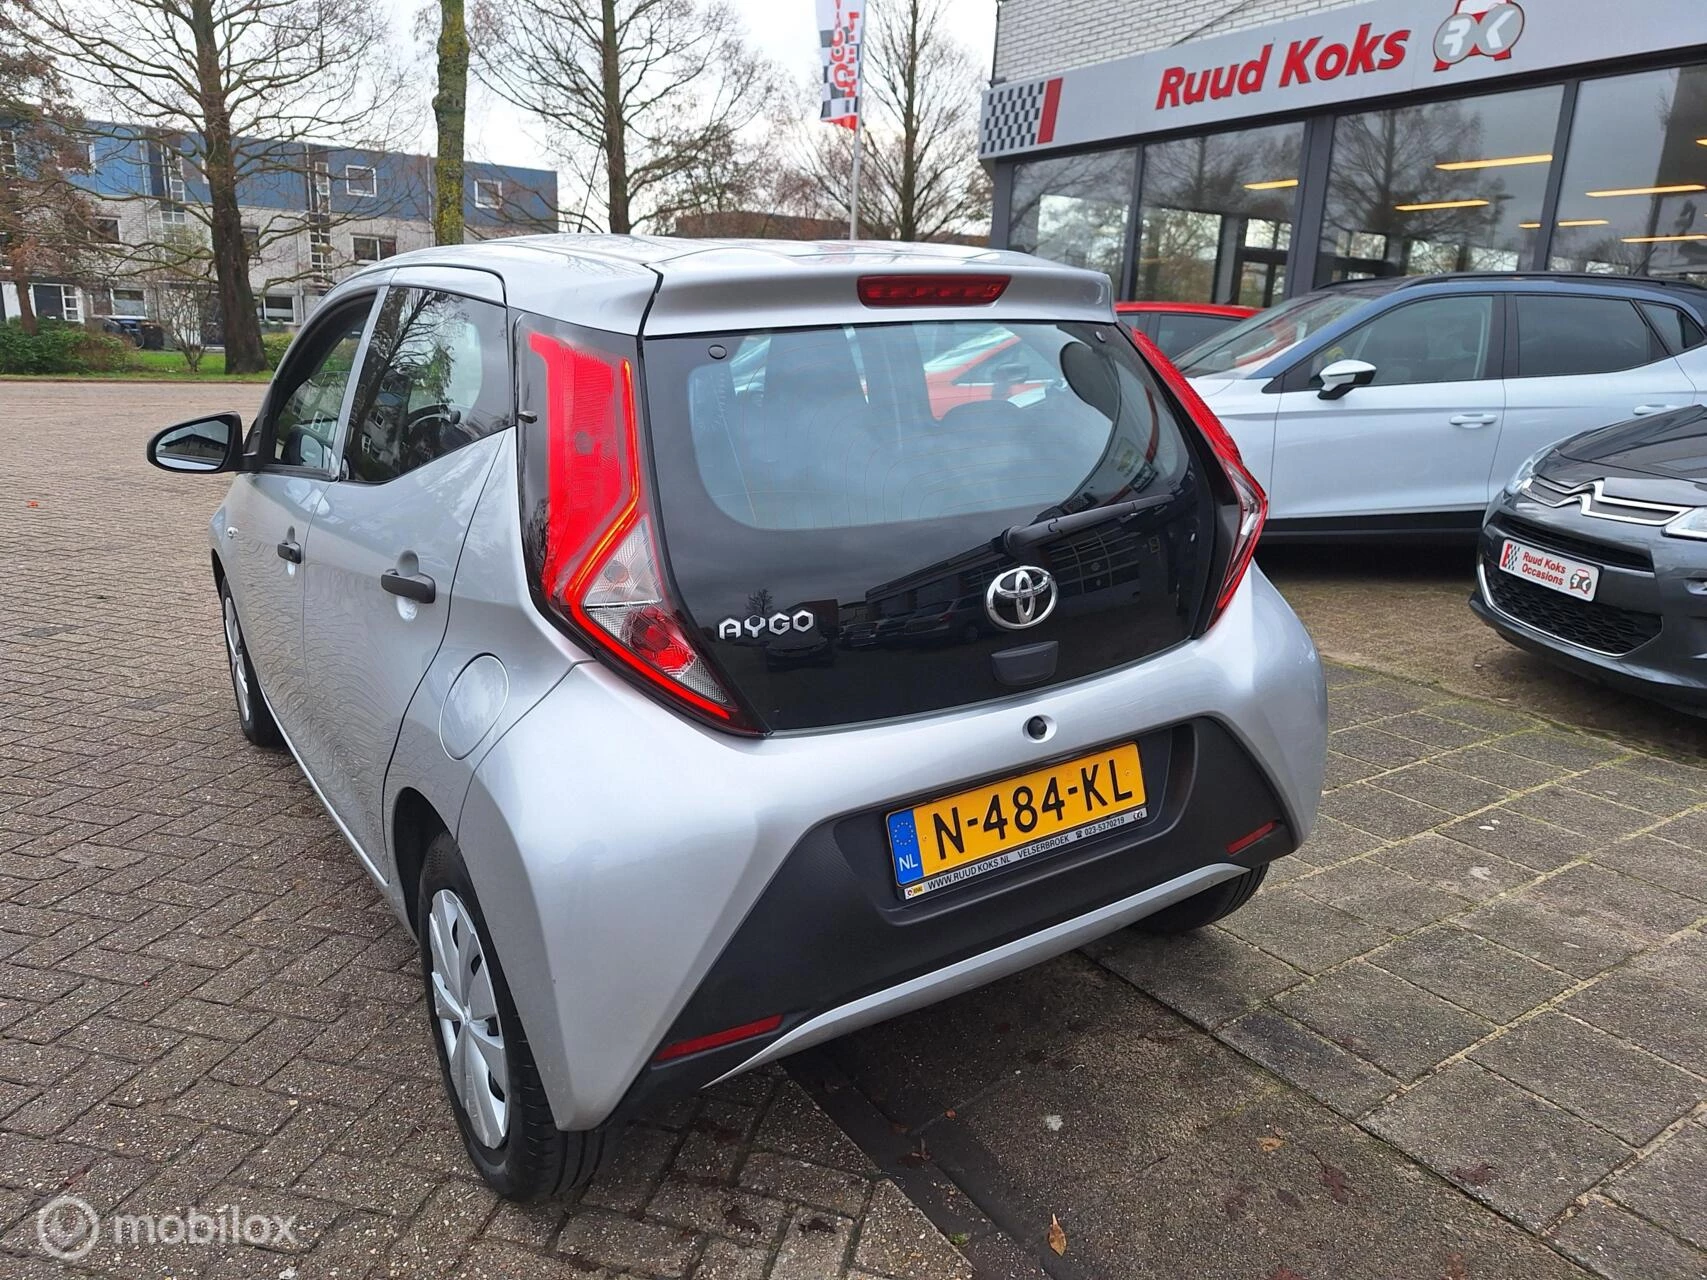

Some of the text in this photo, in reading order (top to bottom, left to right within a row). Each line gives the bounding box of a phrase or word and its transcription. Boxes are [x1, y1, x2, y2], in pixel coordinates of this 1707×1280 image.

[1155, 22, 1411, 110] Ruud Koks
[1521, 563, 1564, 586] Occasions
[1522, 551, 1567, 575] Ruud Koks
[718, 609, 814, 640] AYGO
[932, 759, 1133, 860] N-484-KL
[1017, 834, 1070, 858] VELSERBROEK
[899, 853, 919, 872] NL
